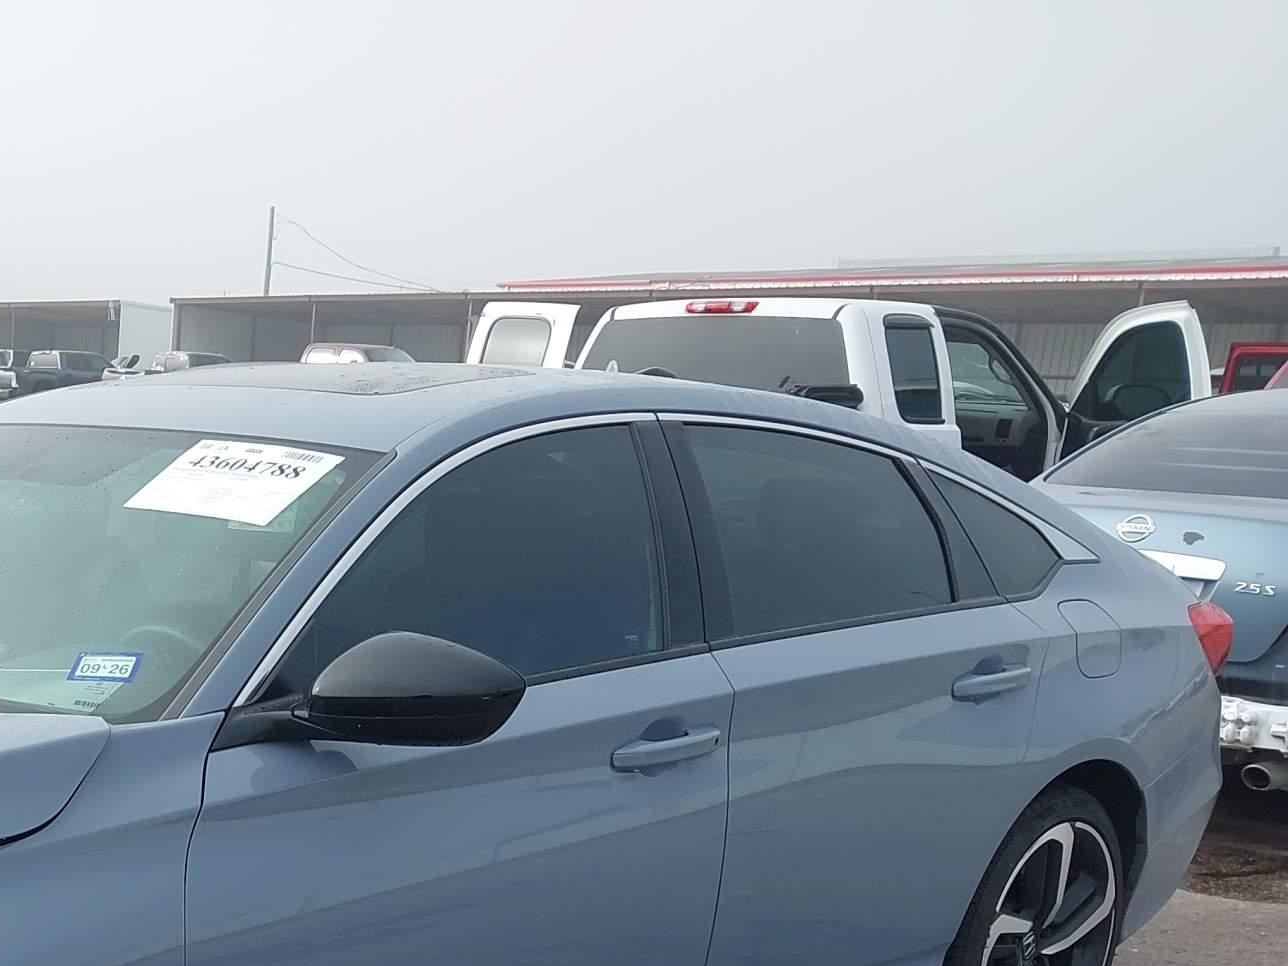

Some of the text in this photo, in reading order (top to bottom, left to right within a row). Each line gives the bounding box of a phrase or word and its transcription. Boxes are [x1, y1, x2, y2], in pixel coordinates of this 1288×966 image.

[189, 455, 307, 480] 43604788
[80, 663, 130, 676] 09 26
